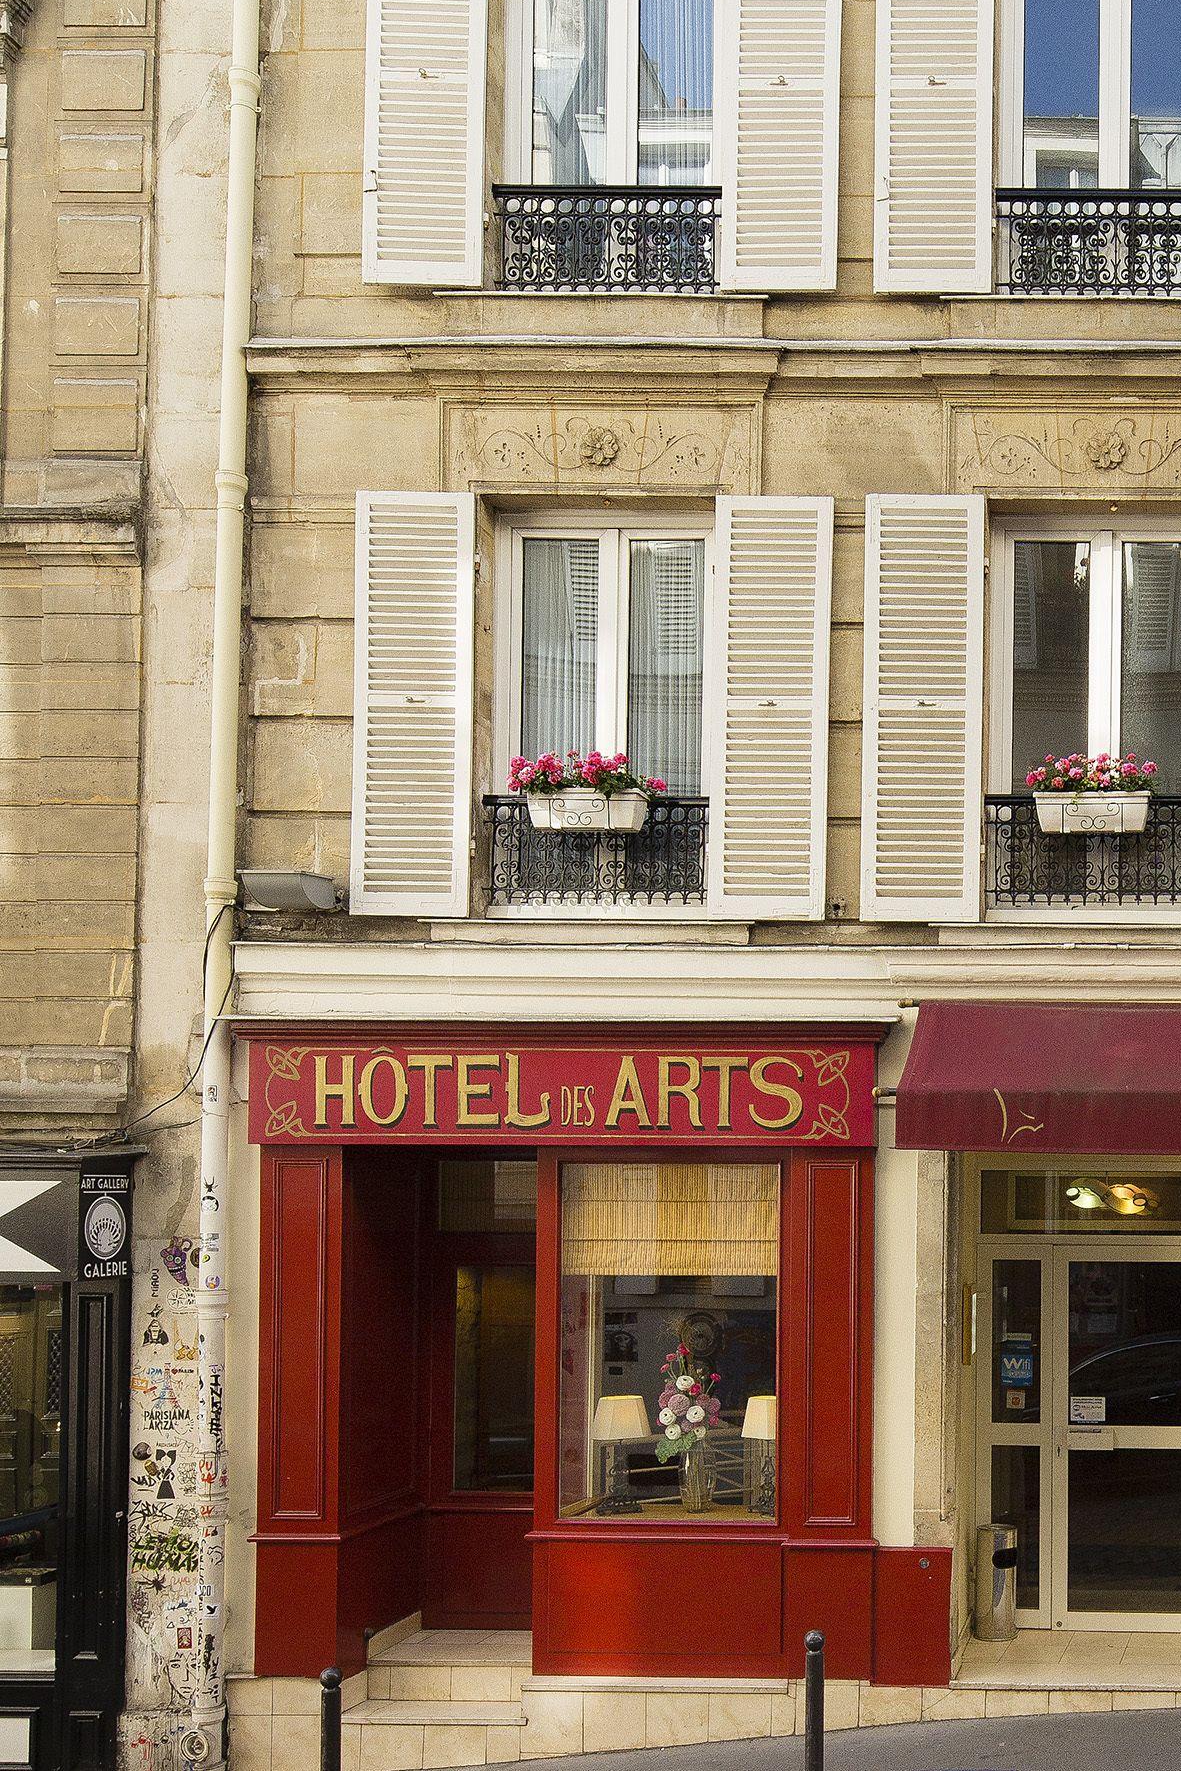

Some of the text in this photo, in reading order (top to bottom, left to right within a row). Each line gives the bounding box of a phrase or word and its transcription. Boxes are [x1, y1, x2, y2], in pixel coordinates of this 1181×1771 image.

[313, 1045, 805, 1129] HÔTEL DES ARTS
[80, 1178, 130, 1189] ART GALLERY
[83, 1261, 128, 1278] GALERIE
